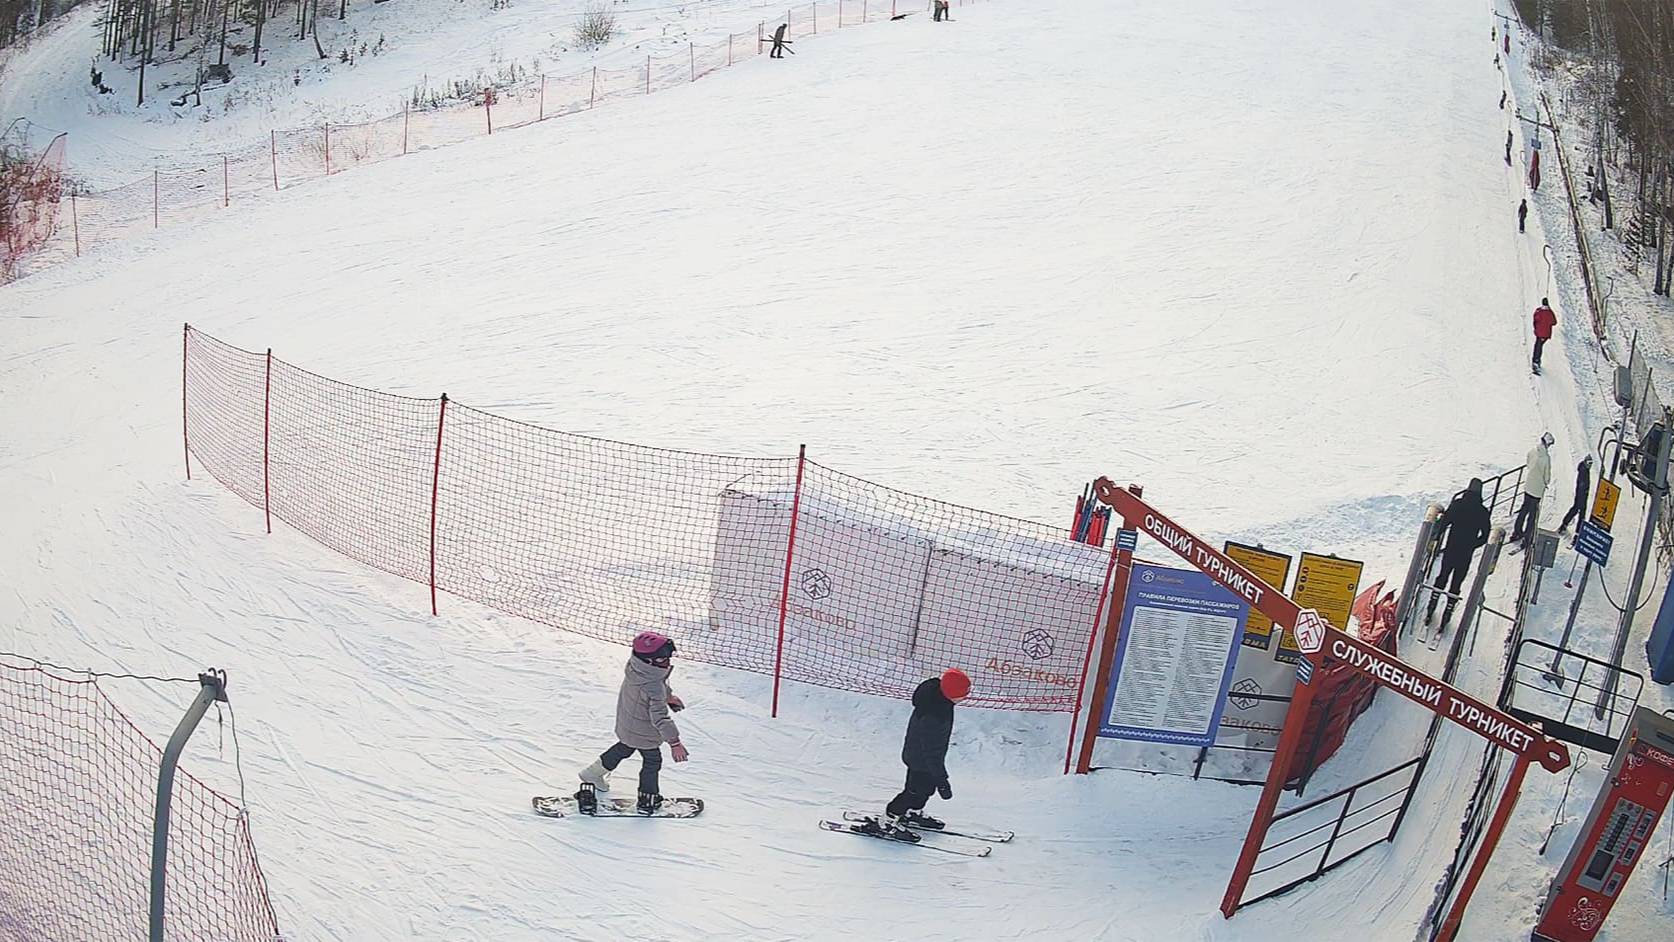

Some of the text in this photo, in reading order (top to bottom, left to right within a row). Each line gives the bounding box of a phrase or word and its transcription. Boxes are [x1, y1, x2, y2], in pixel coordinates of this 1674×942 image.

[1145, 514, 1193, 556] ОБЩИЙ
[1196, 546, 1264, 604] ТУРНИКЕТ
[1138, 592, 1166, 601] ПРАВИЛА
[1200, 599, 1240, 610] ПАССАЖИРОВ
[984, 656, 1076, 689] Абзаково
[1332, 640, 1534, 752] СЛУЖЕБНЫЙ ТУРНИКЕТ
[1647, 748, 1674, 767] КОФЕ
